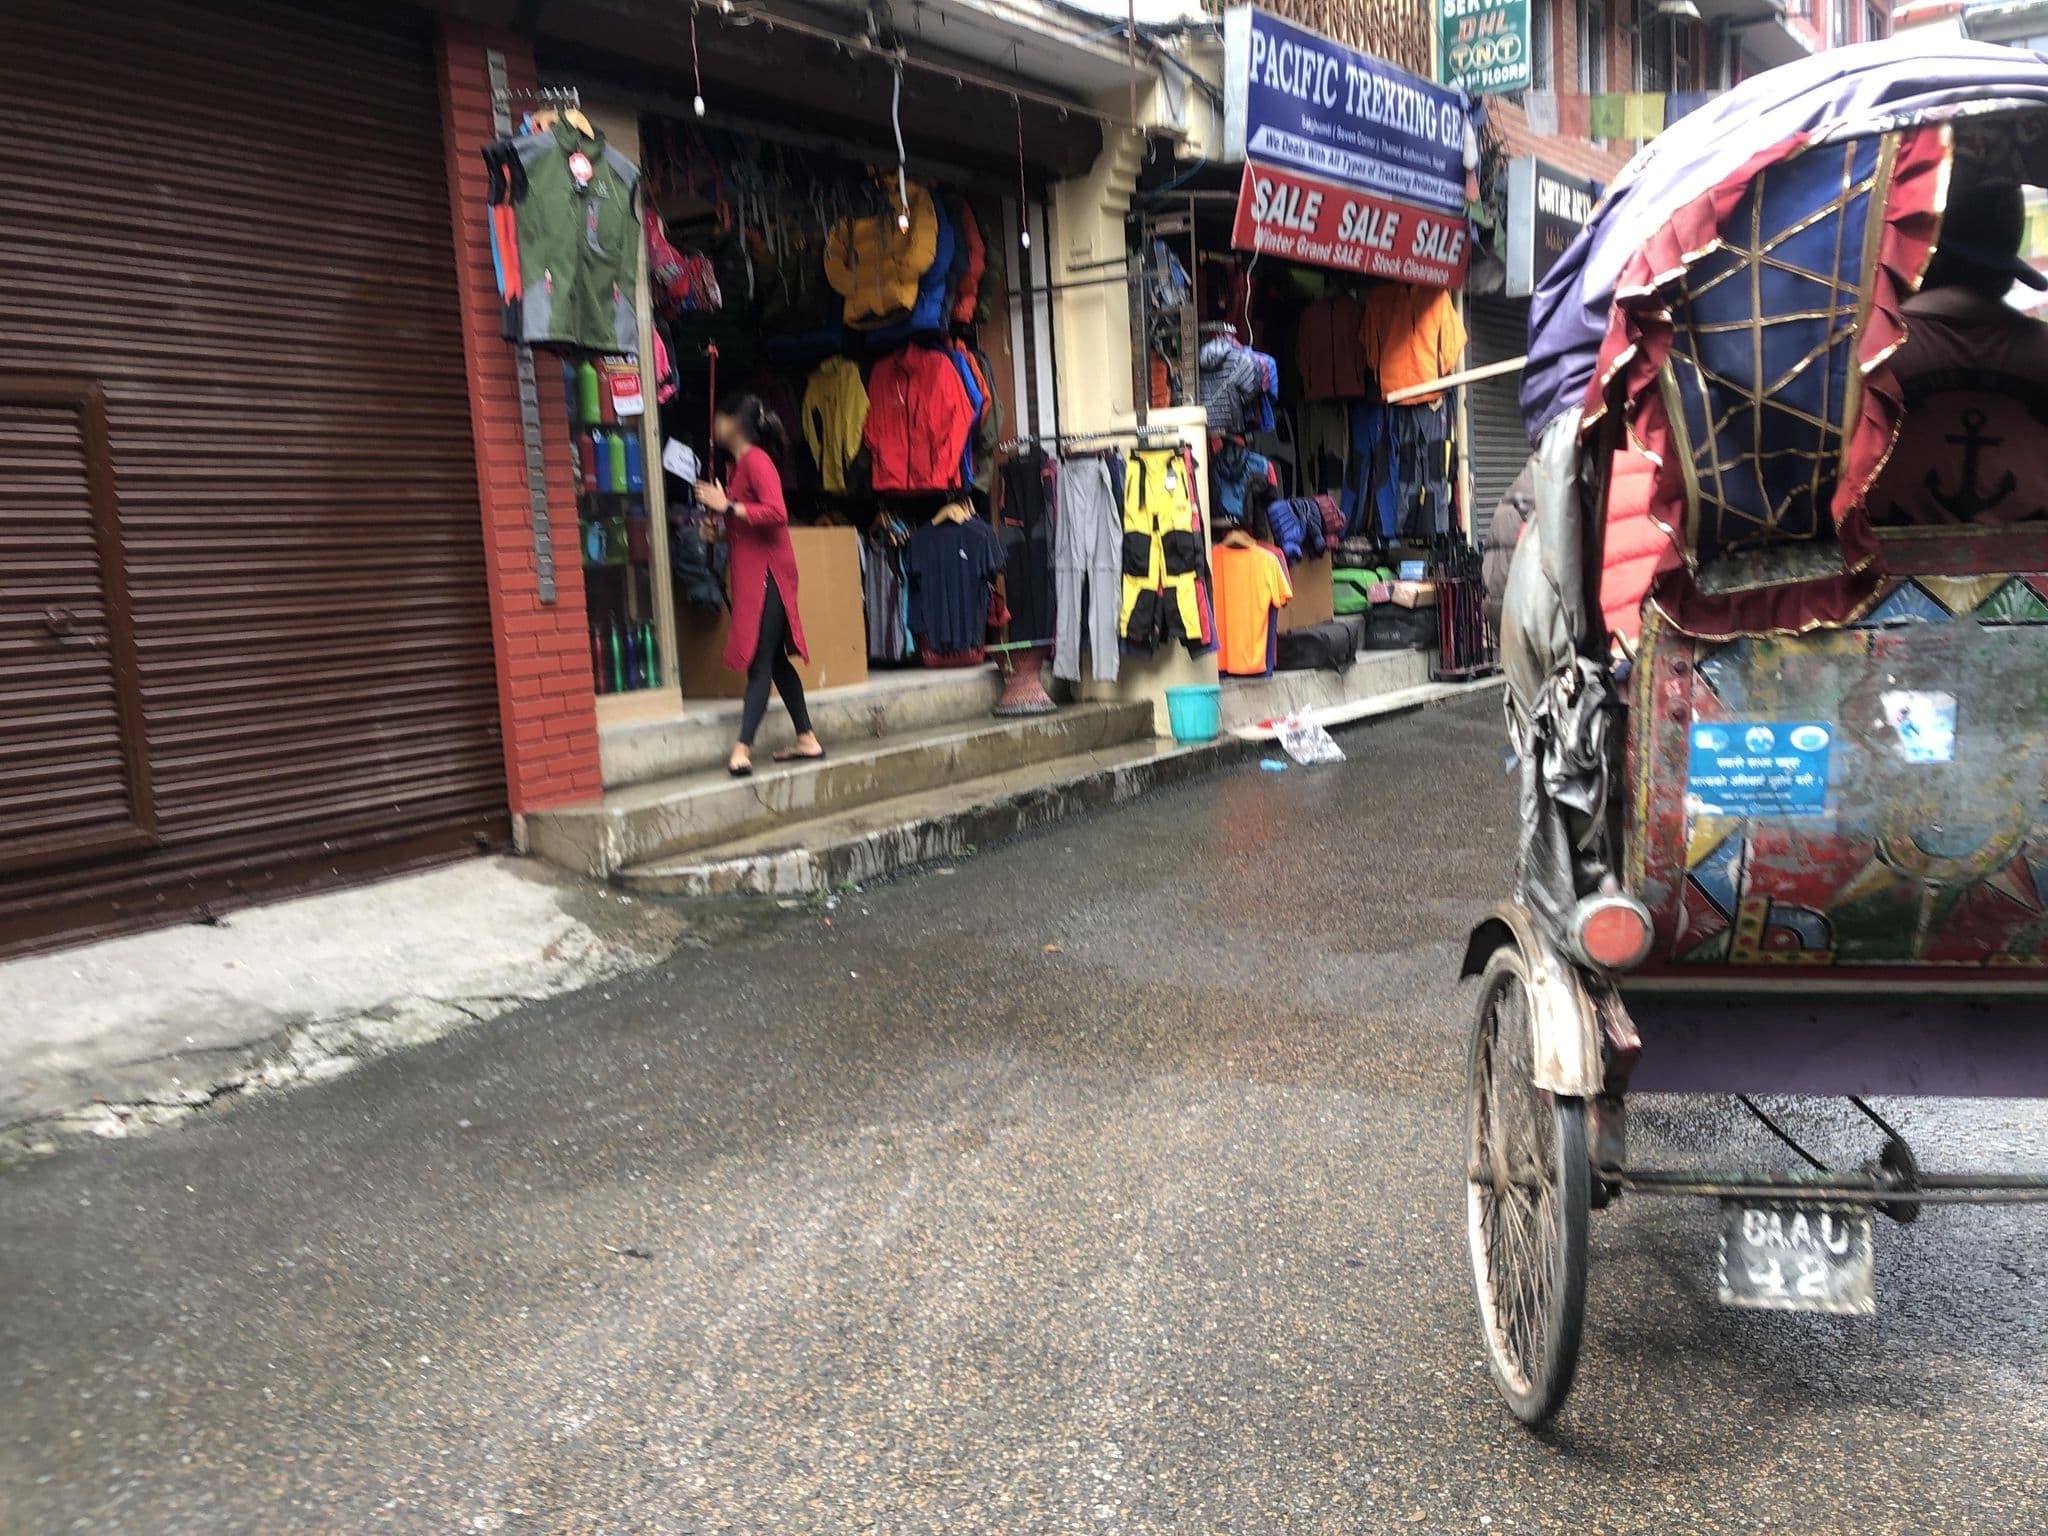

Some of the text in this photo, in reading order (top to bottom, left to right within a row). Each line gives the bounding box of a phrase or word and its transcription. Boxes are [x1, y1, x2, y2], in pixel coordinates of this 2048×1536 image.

[1451, 35, 1518, 73] TNT
[1458, 9, 1508, 41] DHL
[1250, 29, 1339, 108] PACIFIC
[1345, 63, 1437, 141] TREKKING
[1265, 129, 1280, 149] We
[1282, 134, 1305, 159] Deals
[1308, 142, 1326, 163] With
[1328, 149, 1341, 167] All
[1343, 154, 1366, 178] Types
[1367, 158, 1376, 179] of
[1380, 161, 1412, 192] Trekking
[1413, 173, 1438, 193] Related
[1251, 178, 1465, 266] SALE SALE SALE
[1254, 226, 1449, 285] Winter Grand SALE Stock Clearance
